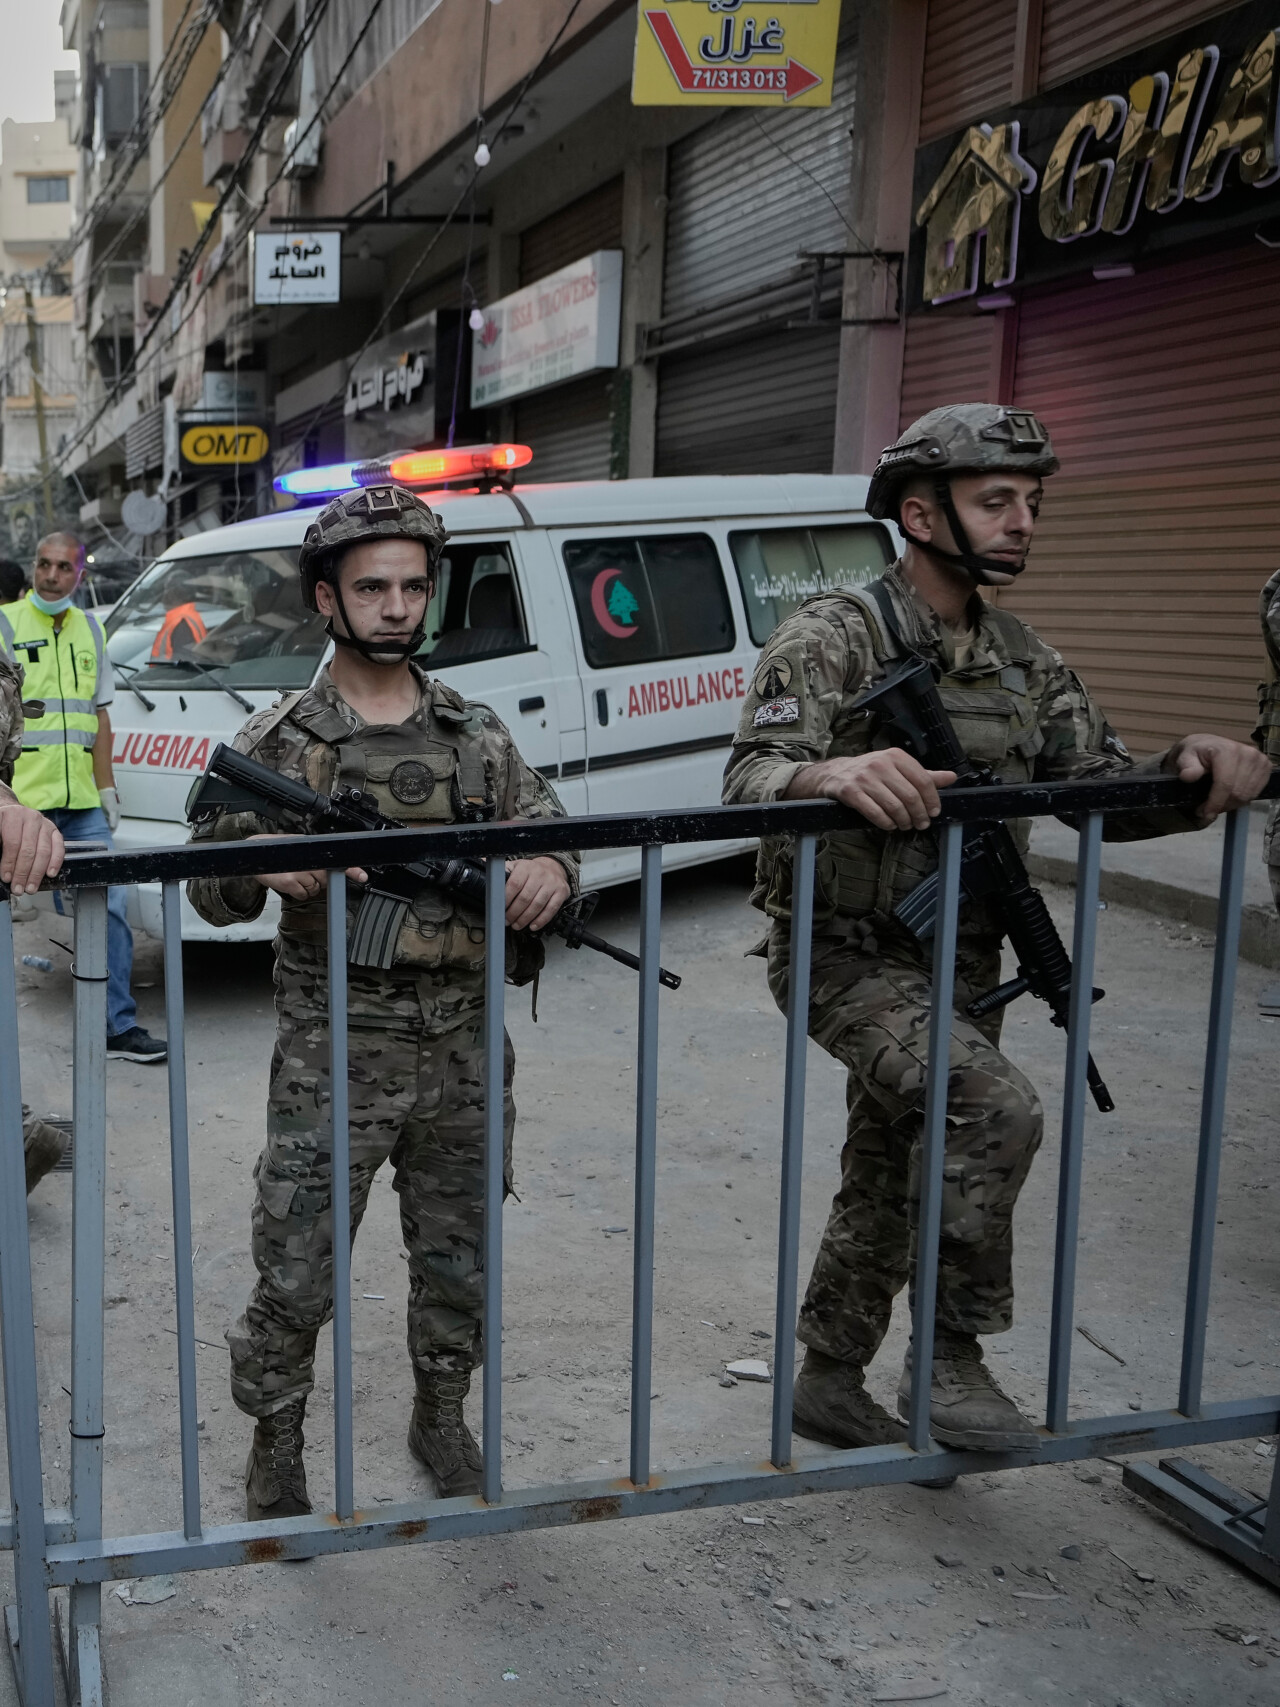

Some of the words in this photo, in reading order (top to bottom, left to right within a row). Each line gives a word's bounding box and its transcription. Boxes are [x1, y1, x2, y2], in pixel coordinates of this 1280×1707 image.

[699, 16, 784, 62] غزل
[692, 69, 751, 88] 71/313
[754, 70, 787, 89] 013
[538, 271, 597, 320] FLOWERS
[193, 432, 257, 457] OMT
[628, 666, 745, 718] AMBULANCE
